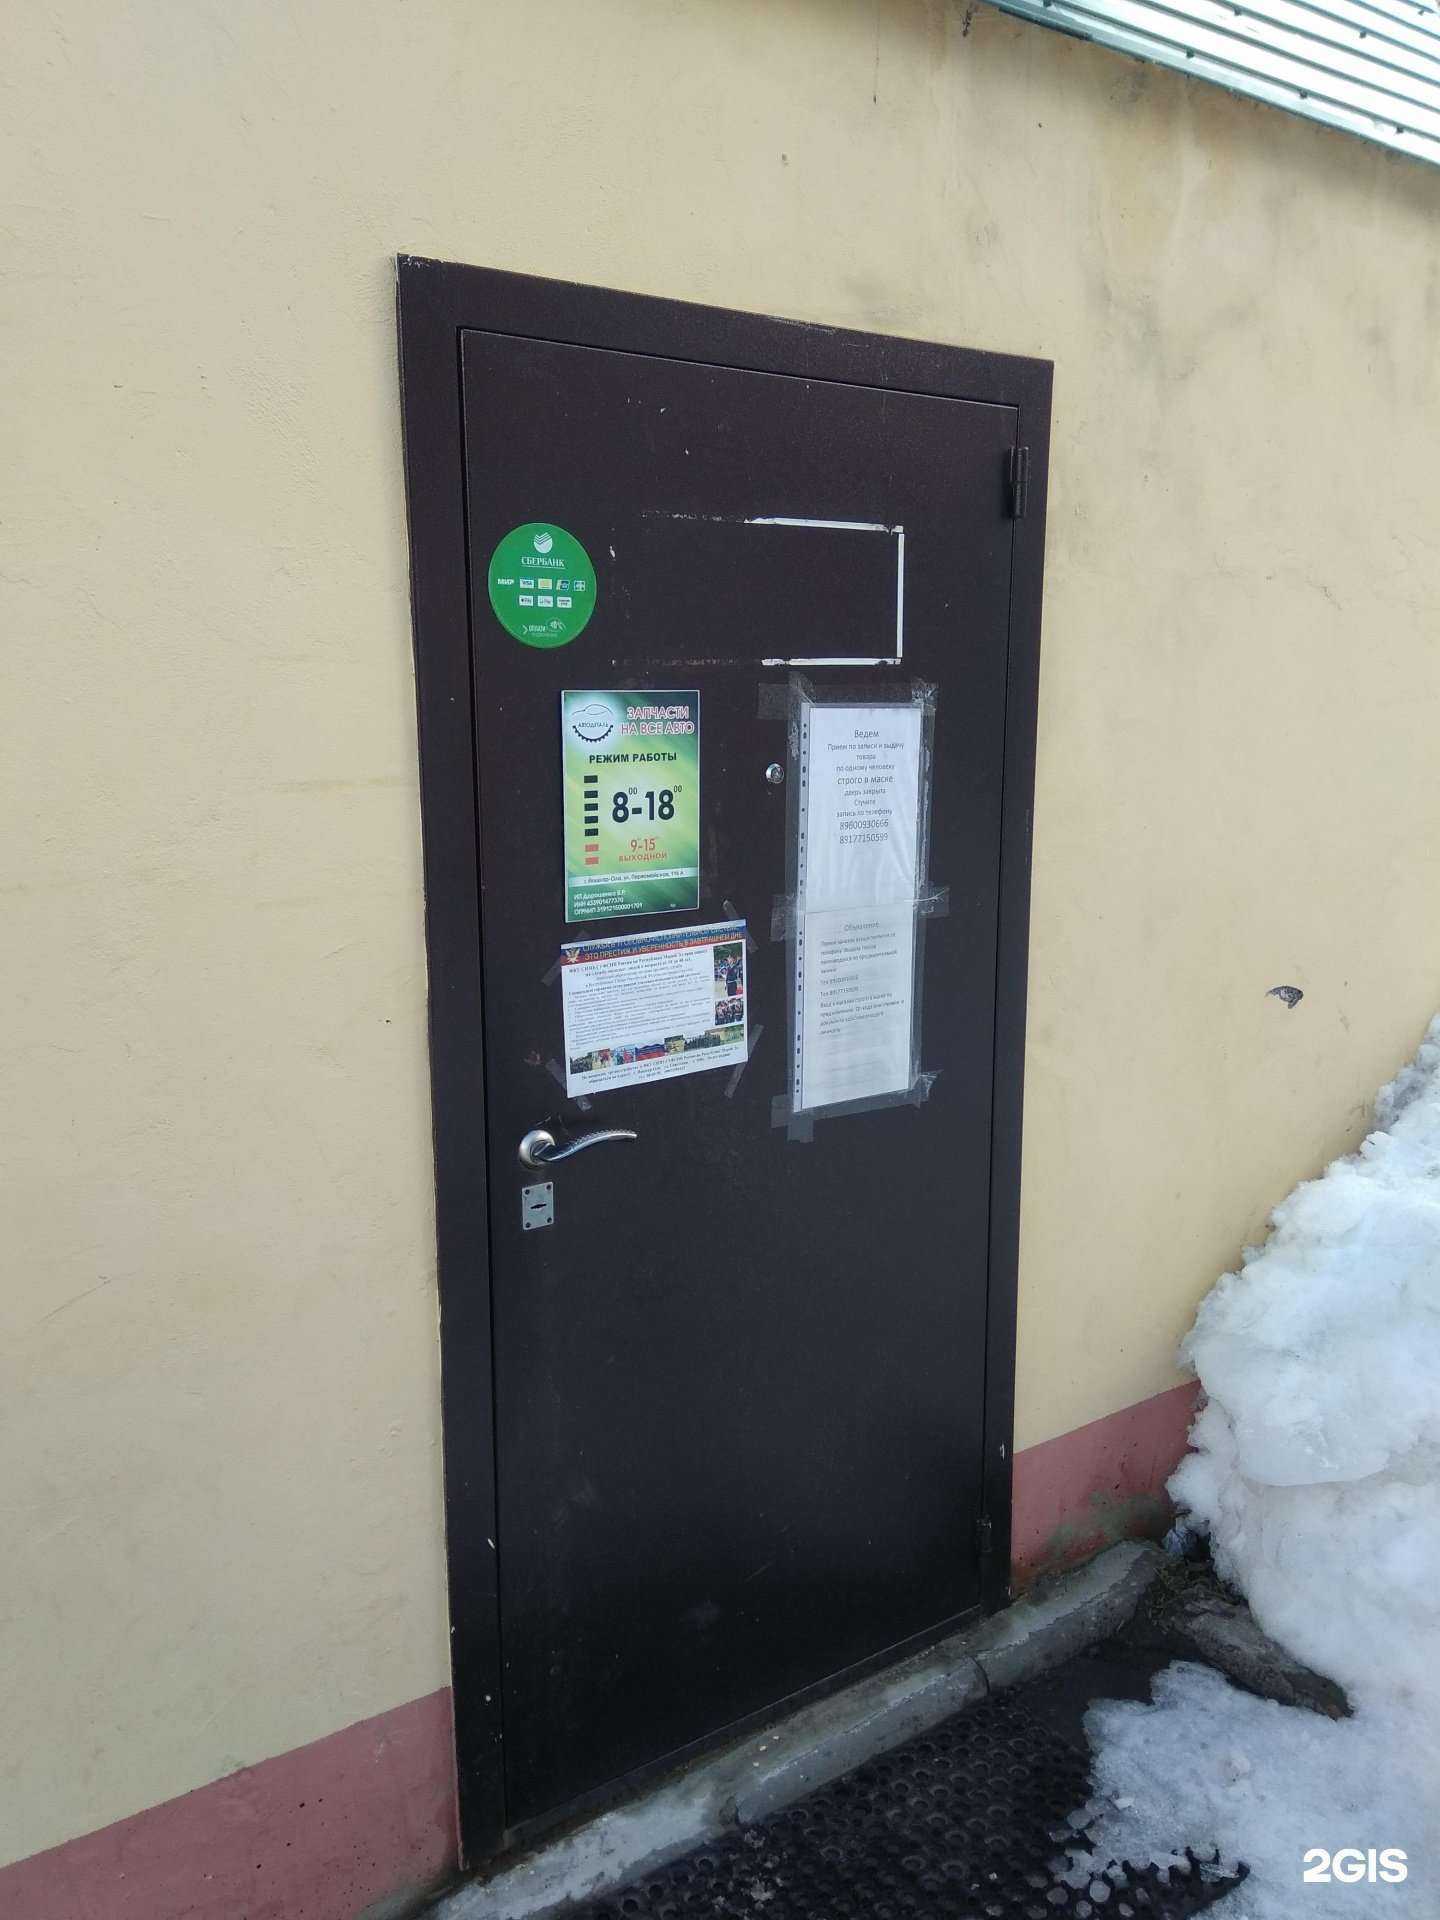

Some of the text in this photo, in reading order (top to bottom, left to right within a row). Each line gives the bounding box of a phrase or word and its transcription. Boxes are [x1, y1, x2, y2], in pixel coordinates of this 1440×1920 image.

[521, 556, 565, 567] СБЕРБАНК
[626, 706, 690, 720] ЗАПЧАСТИ
[620, 720, 695, 736] НА ВСЕ АВТО
[854, 729, 880, 739] Ведем
[589, 752, 677, 764] РЕЖИМ РАБОТЫ
[845, 764, 867, 773] одному
[837, 777, 863, 787] строго
[870, 775, 894, 783] маске
[584, 952, 599, 961] ЭТО
